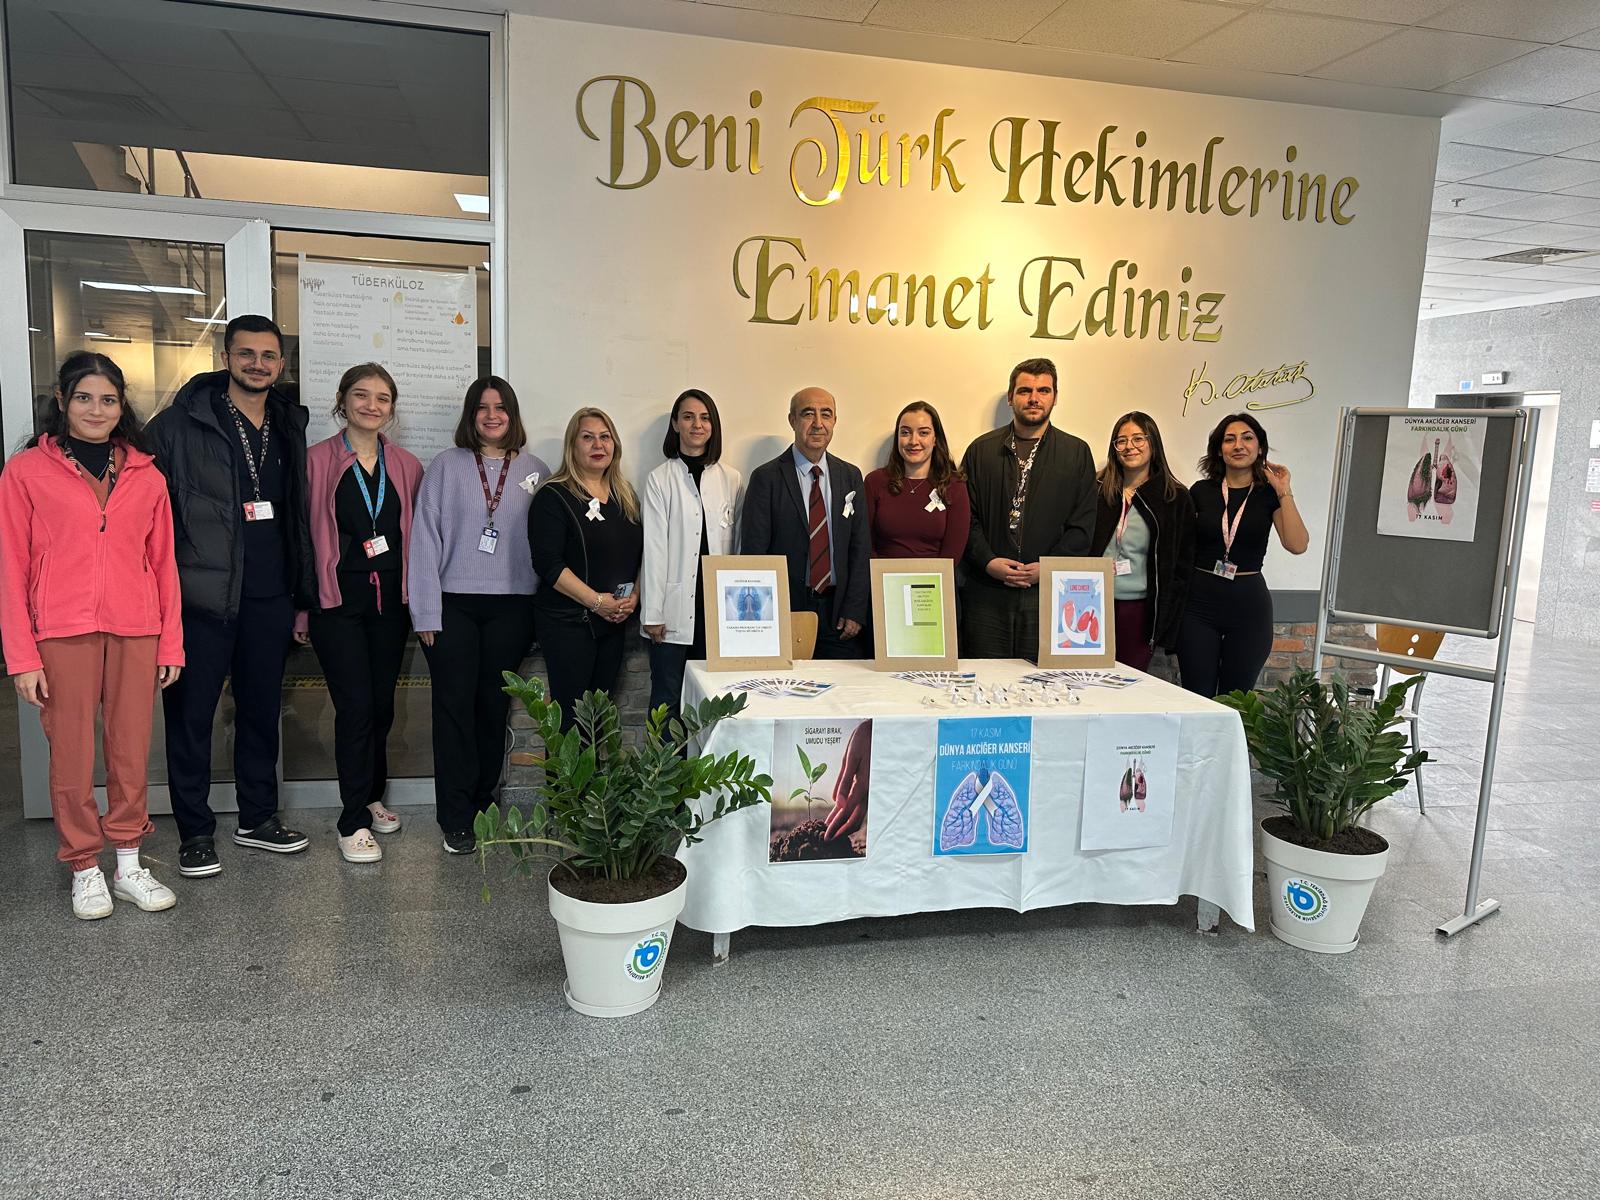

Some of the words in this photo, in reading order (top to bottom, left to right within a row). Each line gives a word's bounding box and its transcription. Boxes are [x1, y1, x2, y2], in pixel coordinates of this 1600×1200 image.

[576, 75, 765, 189] Beni
[790, 96, 966, 206] Türk
[989, 116, 1360, 225] Hekimlerine
[352, 273, 425, 291] TÜBERKÜLOZ
[733, 235, 996, 330] Emanet
[1018, 256, 1226, 342] Ediniz
[1425, 417, 1450, 425] AKCİĞER
[1451, 417, 1477, 425] KANSERİ
[805, 726, 826, 735] SİGARAYI
[971, 728, 978, 738] 17
[979, 728, 1002, 737] KASIM
[824, 737, 841, 746] YEŞERT
[939, 743, 965, 756] DÜNYA
[966, 742, 997, 755] AKCİĞER
[998, 741, 1031, 754] KANSERİ
